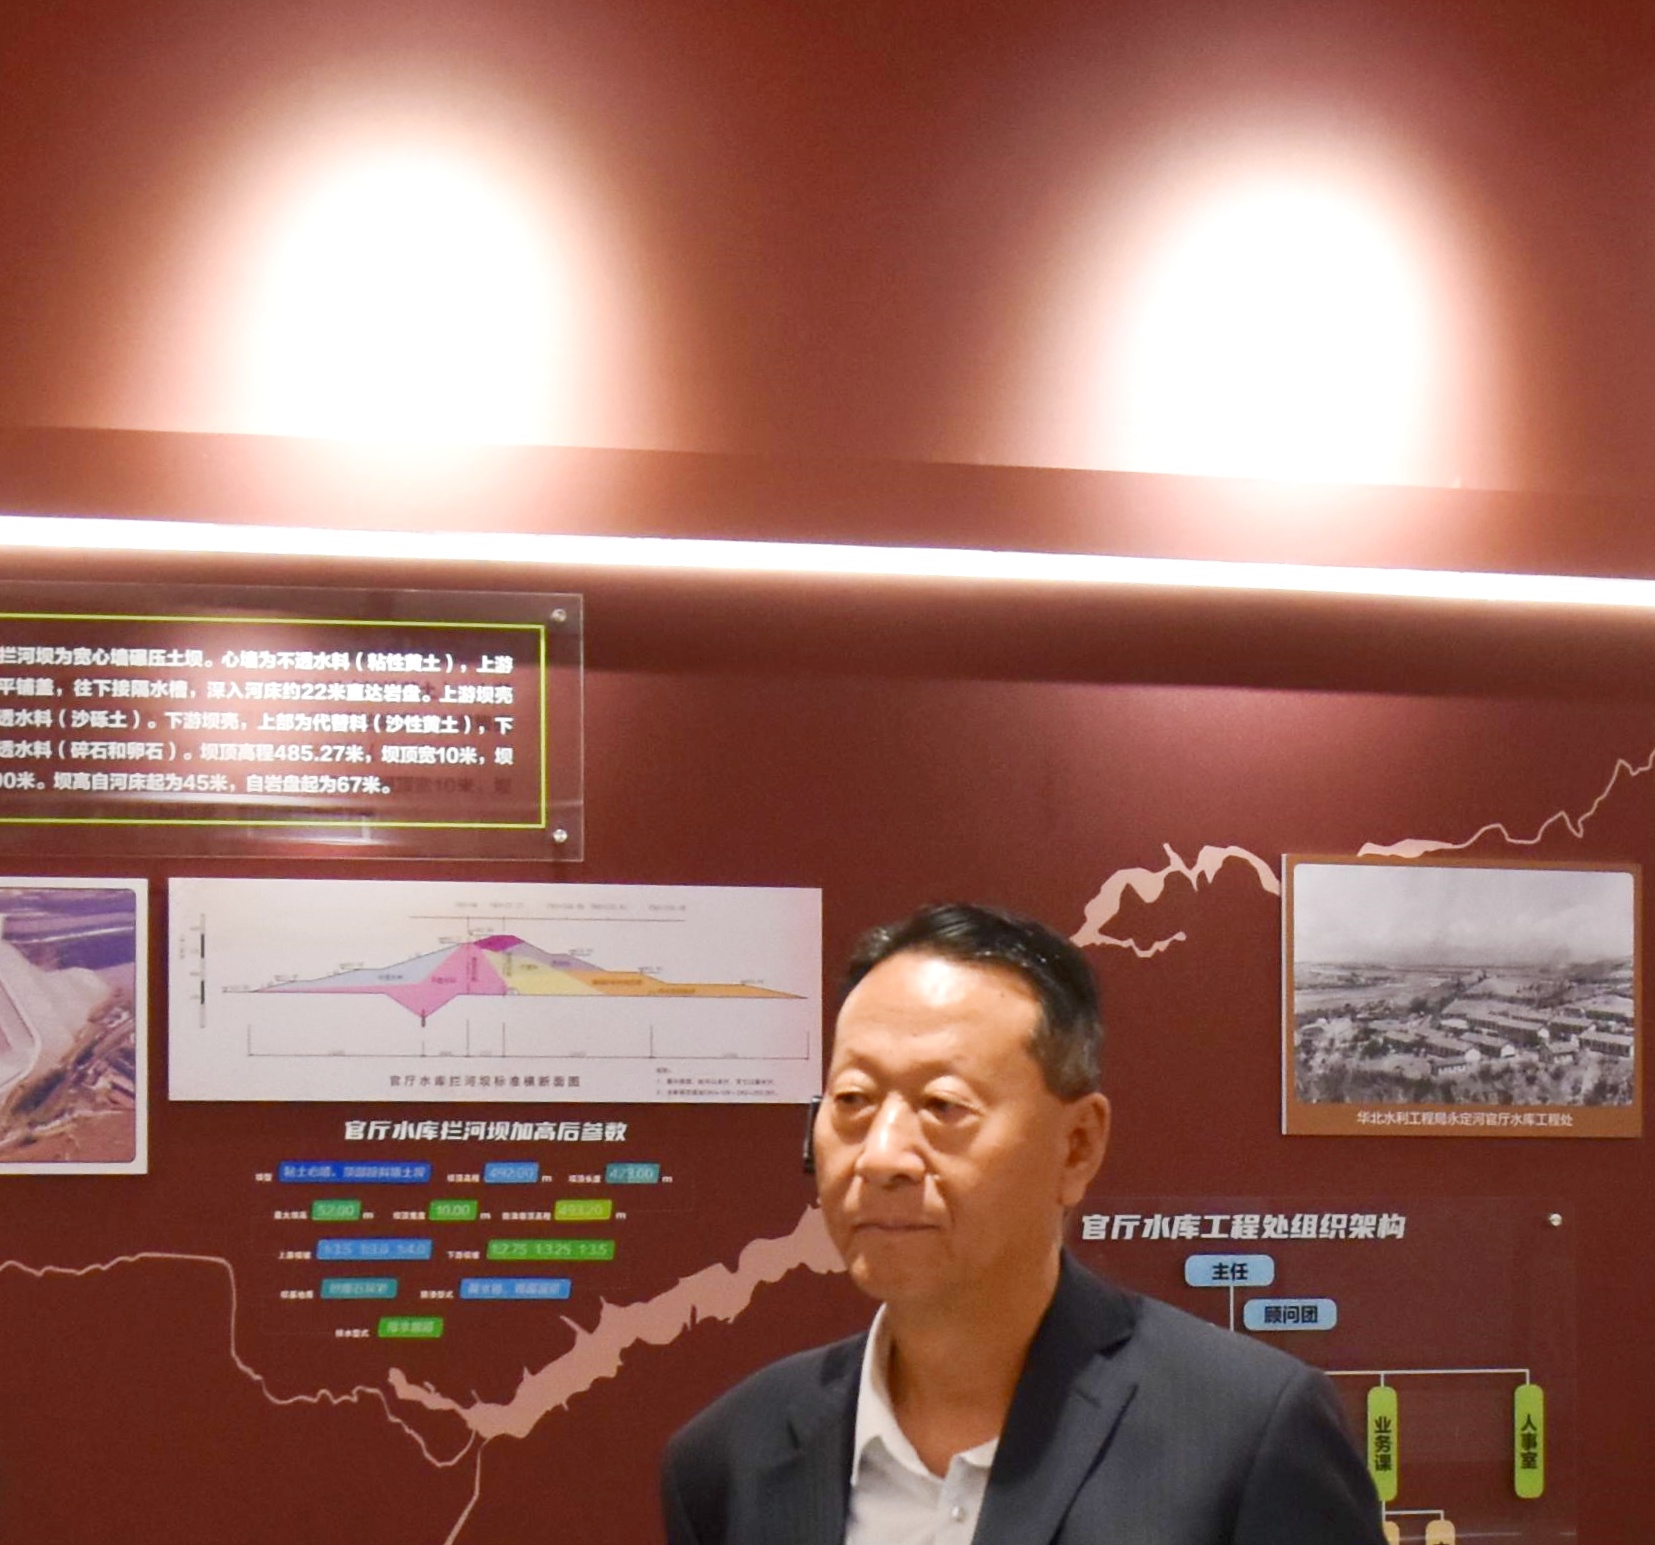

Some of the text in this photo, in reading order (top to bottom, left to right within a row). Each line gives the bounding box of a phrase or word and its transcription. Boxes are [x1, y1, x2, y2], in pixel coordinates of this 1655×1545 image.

[343, 1119, 628, 1143] 官厅水库拦河坝加高后参数
[1080, 1212, 1407, 1242] 官厅水库工程处组织架构
[1211, 1261, 1249, 1282] 主任
[1263, 1304, 1319, 1325] 顾问团
[1373, 1414, 1393, 1473] 业务课
[1519, 1413, 1539, 1471] 人事室
